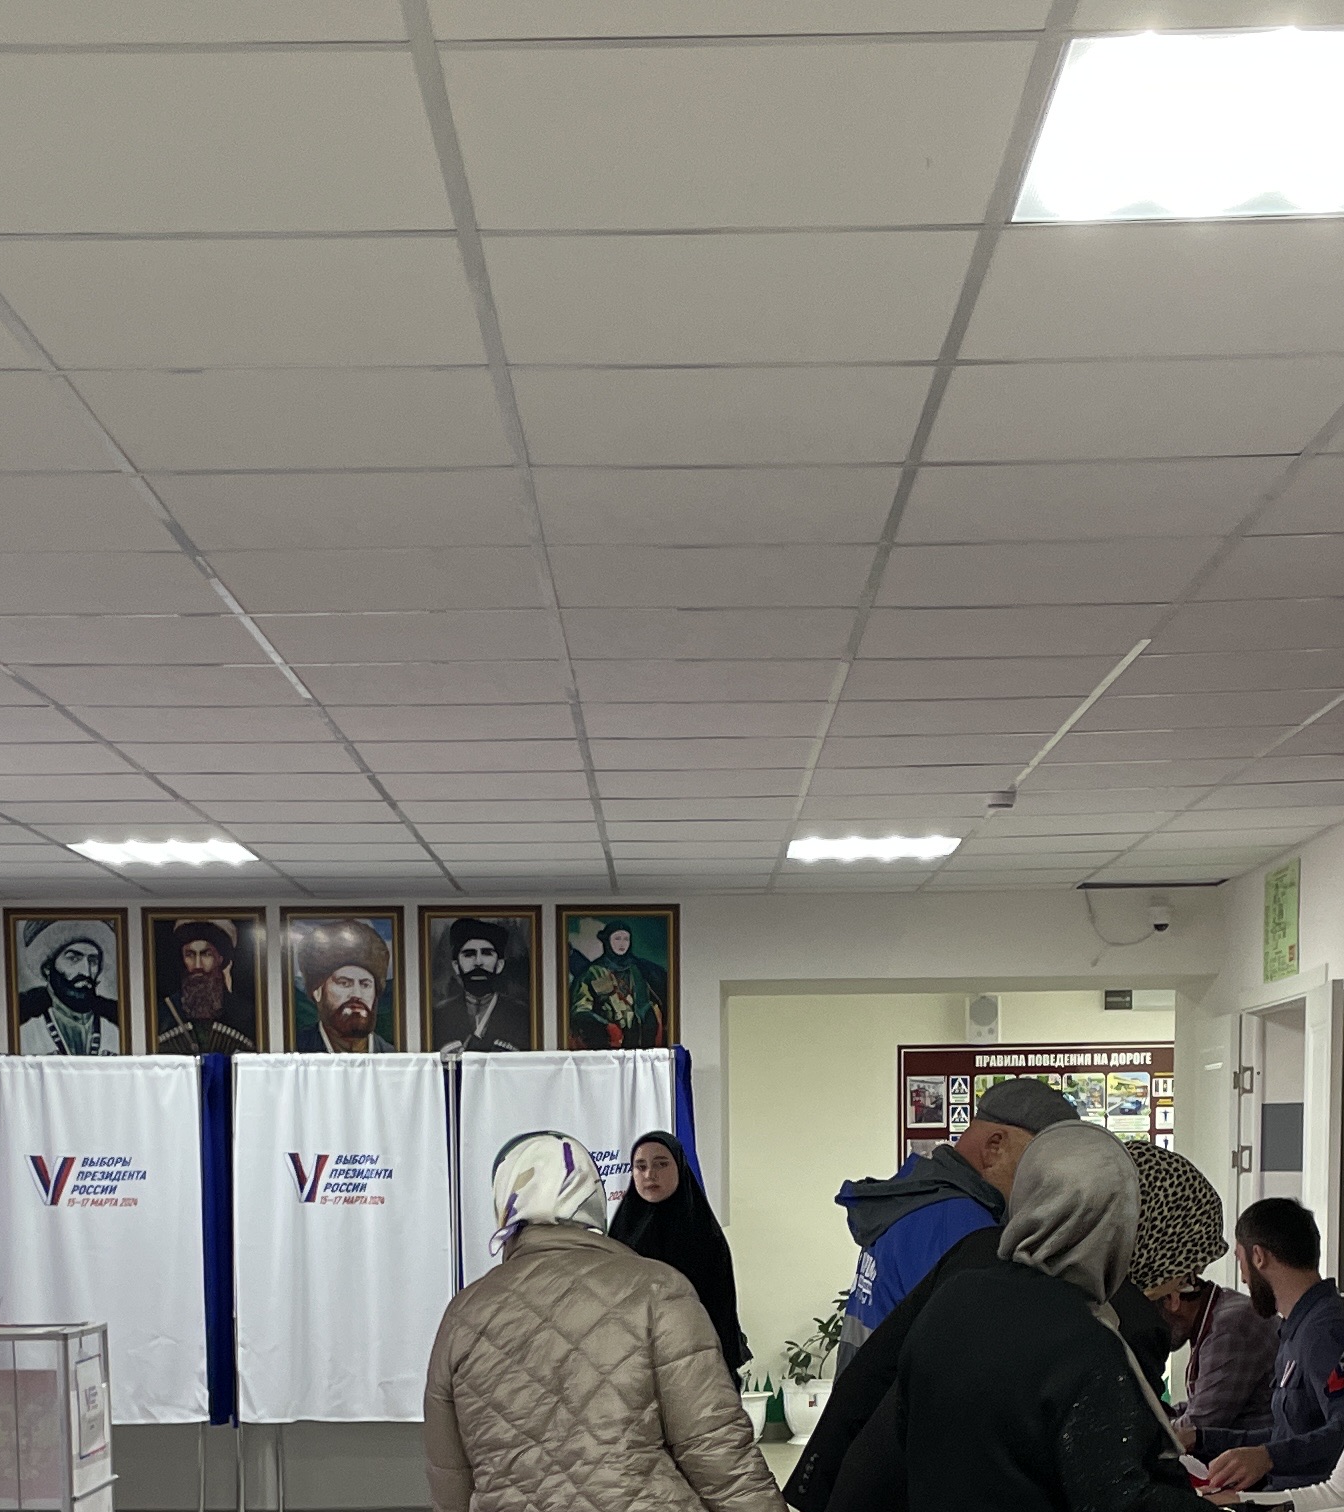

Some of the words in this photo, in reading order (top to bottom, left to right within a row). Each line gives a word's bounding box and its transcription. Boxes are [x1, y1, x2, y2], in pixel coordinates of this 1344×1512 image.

[975, 1054, 1026, 1067] ПРАВИЛА
[1028, 1053, 1092, 1068] ПОВЕДЕНИЯ
[1093, 1053, 1109, 1066] НА
[1110, 1052, 1152, 1067] ДОРОГЕ
[81, 1157, 132, 1167] ВЫБОРЫ
[335, 1154, 379, 1165] ВЫБОРЫ
[76, 1170, 147, 1182] ПРЕЗИДЕНТА
[329, 1168, 393, 1179] ПРЕЗИДЕНТА
[71, 1185, 118, 1195] РОССИИ
[323, 1182, 367, 1192] РОССИИ
[90, 1198, 118, 1207] МАРТА
[119, 1198, 138, 1207] 2024
[342, 1196, 367, 1205] МАРТА
